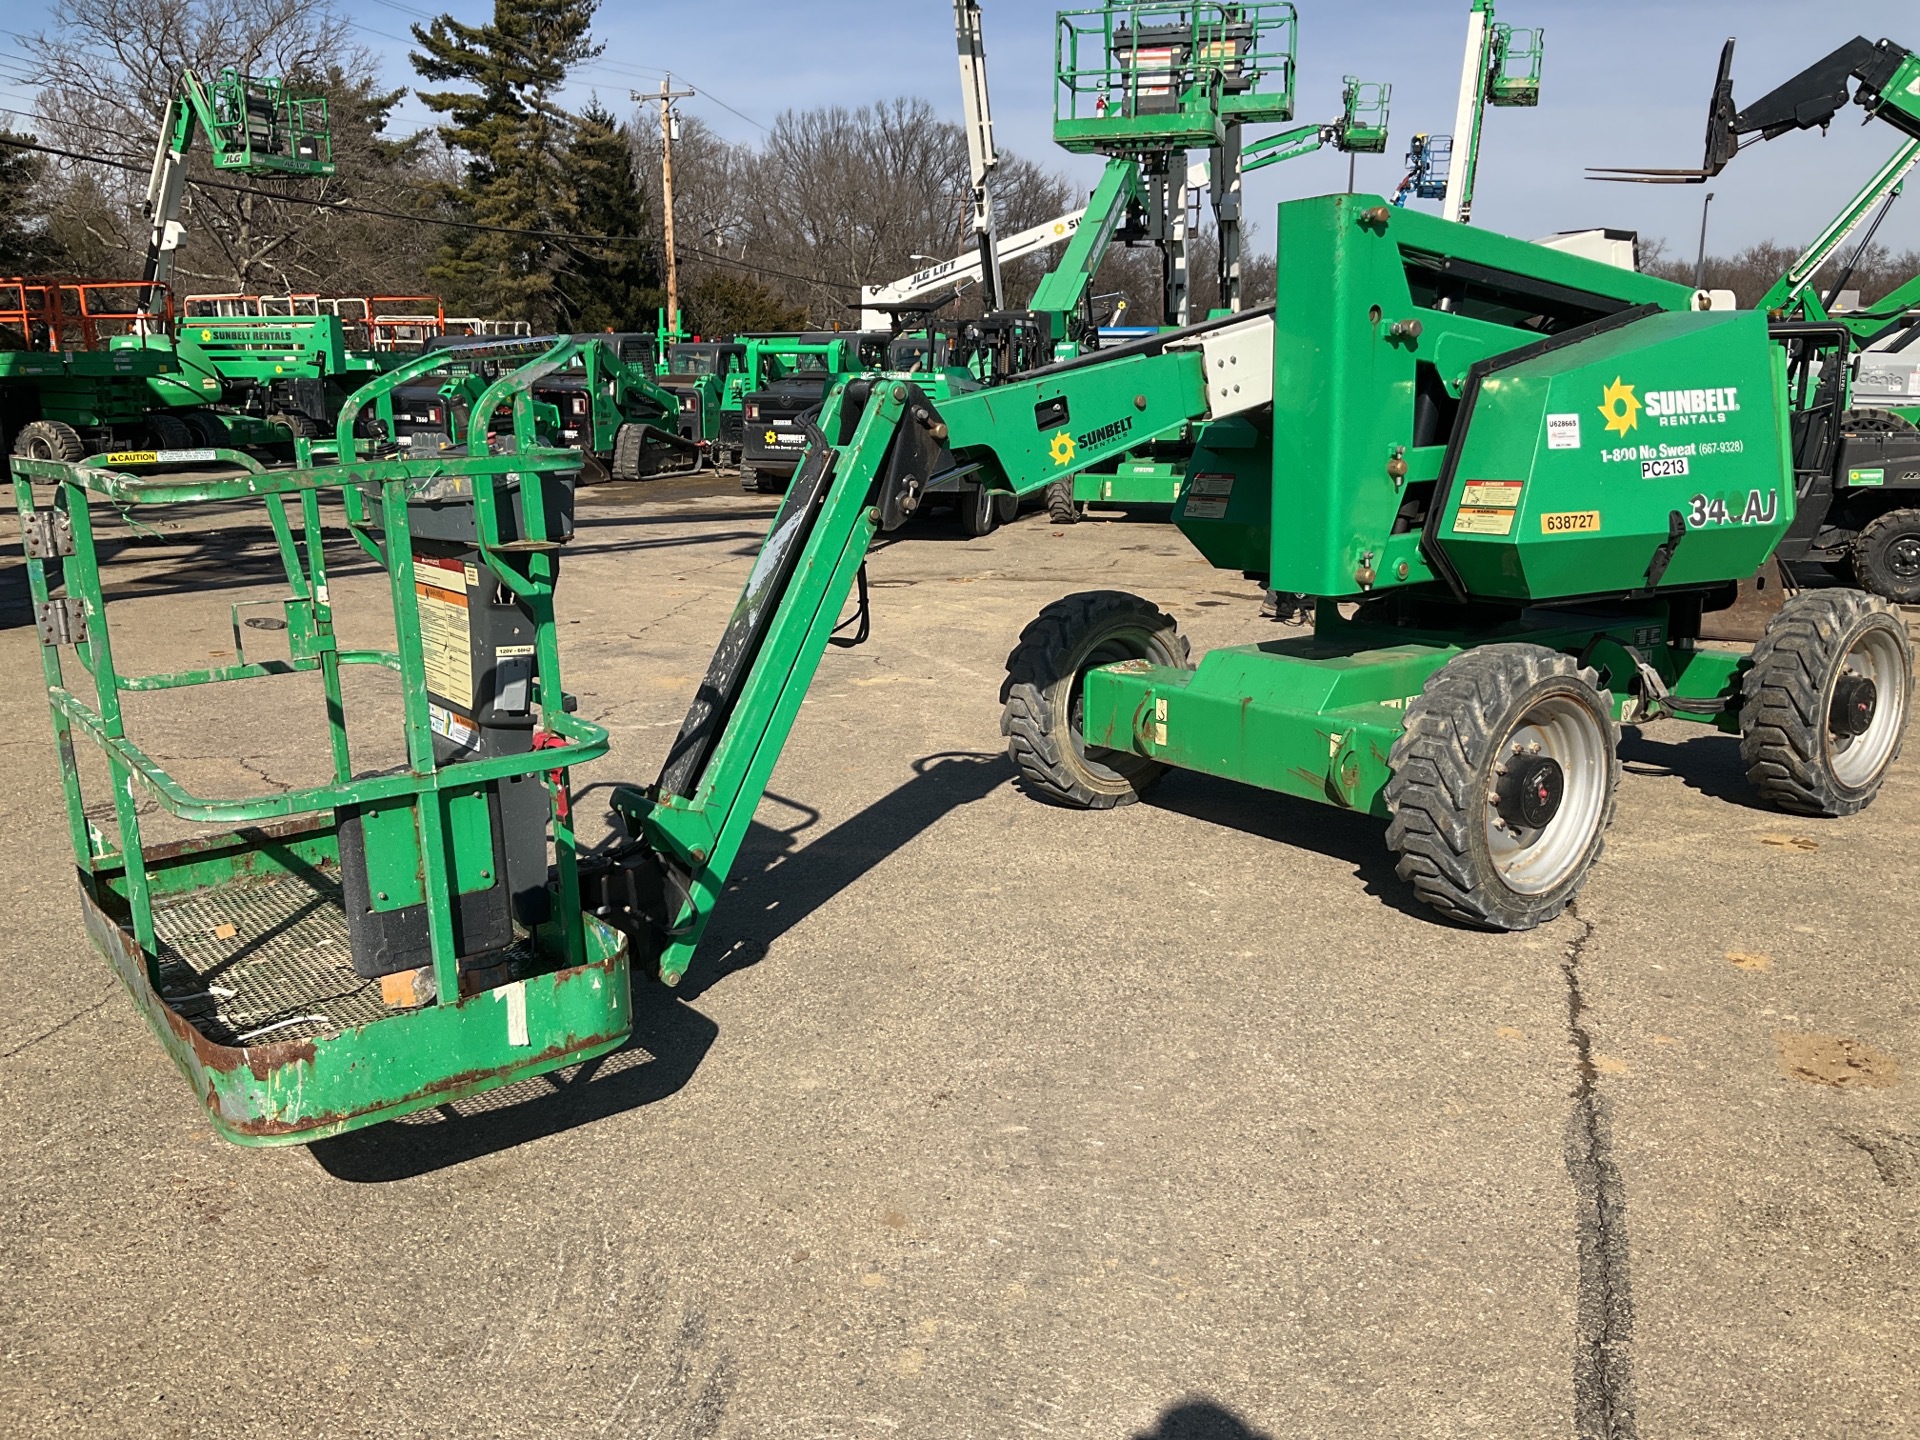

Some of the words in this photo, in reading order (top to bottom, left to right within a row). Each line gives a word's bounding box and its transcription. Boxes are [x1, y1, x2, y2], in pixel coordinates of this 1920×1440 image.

[223, 153, 242, 164] JLG
[910, 269, 930, 285] JLG
[932, 260, 956, 276] LIFT
[213, 331, 250, 340] SUNBELT
[252, 331, 292, 341] RENTALS
[1859, 373, 1903, 385] Genie
[1644, 387, 1737, 416] SUNBELT
[1549, 420, 1577, 428] U628665
[1659, 412, 1726, 427] RENTALS
[1077, 415, 1132, 450] SUNBELT
[1087, 431, 1129, 452] RENTALS
[117, 453, 155, 462] CAUTION
[1601, 447, 1637, 463] 1-800
[1639, 445, 1657, 459] No
[1659, 442, 1696, 457] Sweat
[1699, 439, 1744, 456] (667-9328)
[1641, 459, 1685, 478] PC213
[1688, 488, 1778, 528] 34AJ
[1547, 514, 1594, 531] 638727
